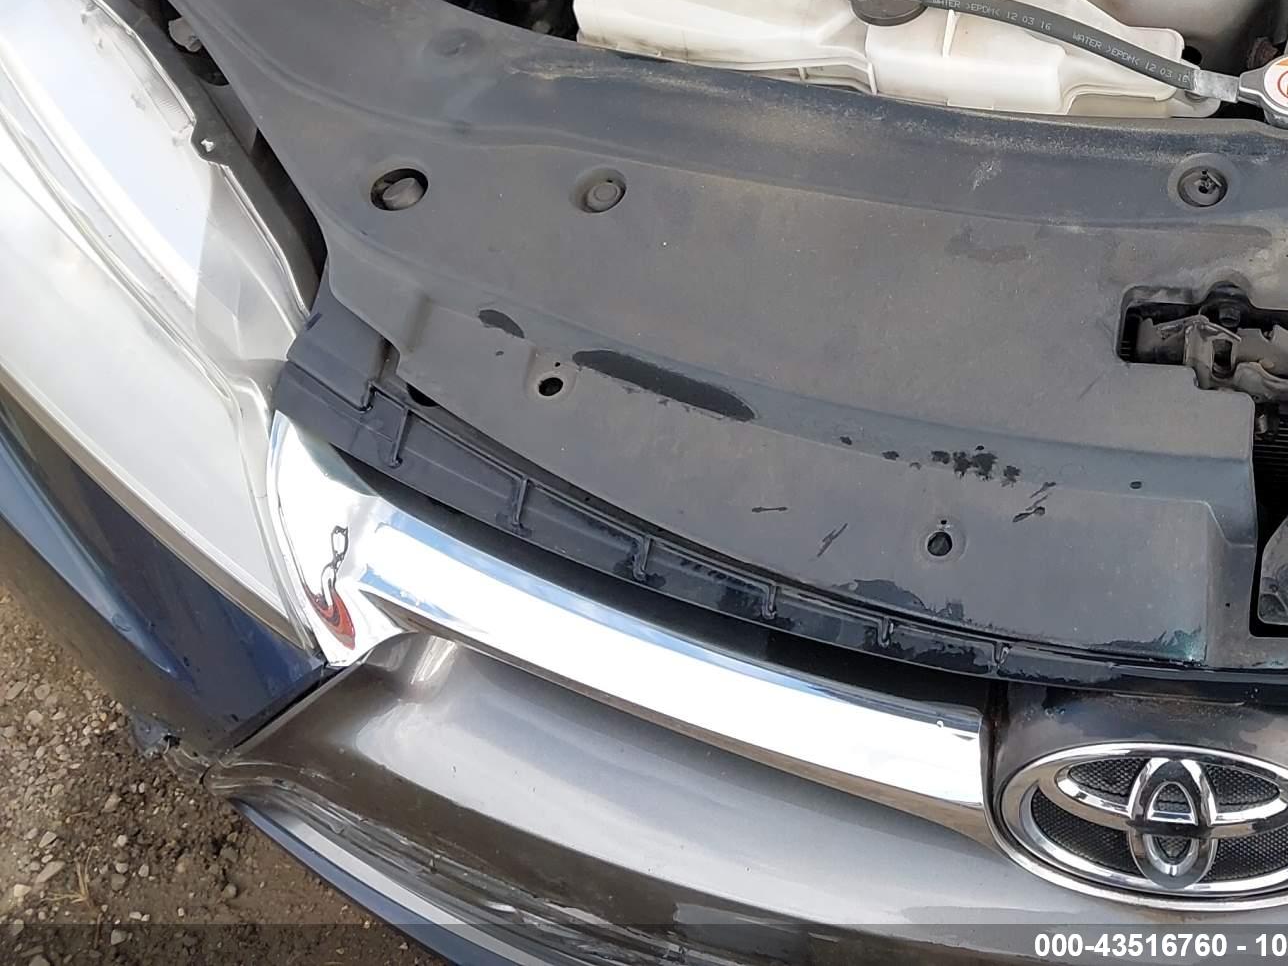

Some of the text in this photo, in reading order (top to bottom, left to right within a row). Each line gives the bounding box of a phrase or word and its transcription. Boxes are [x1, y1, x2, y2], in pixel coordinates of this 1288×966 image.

[1006, 11, 1018, 21] 12
[1022, 16, 1035, 25] 03
[1040, 21, 1053, 31] 16
[1072, 32, 1102, 49] WATER
[1145, 61, 1157, 72] 12
[1160, 67, 1173, 78] 03
